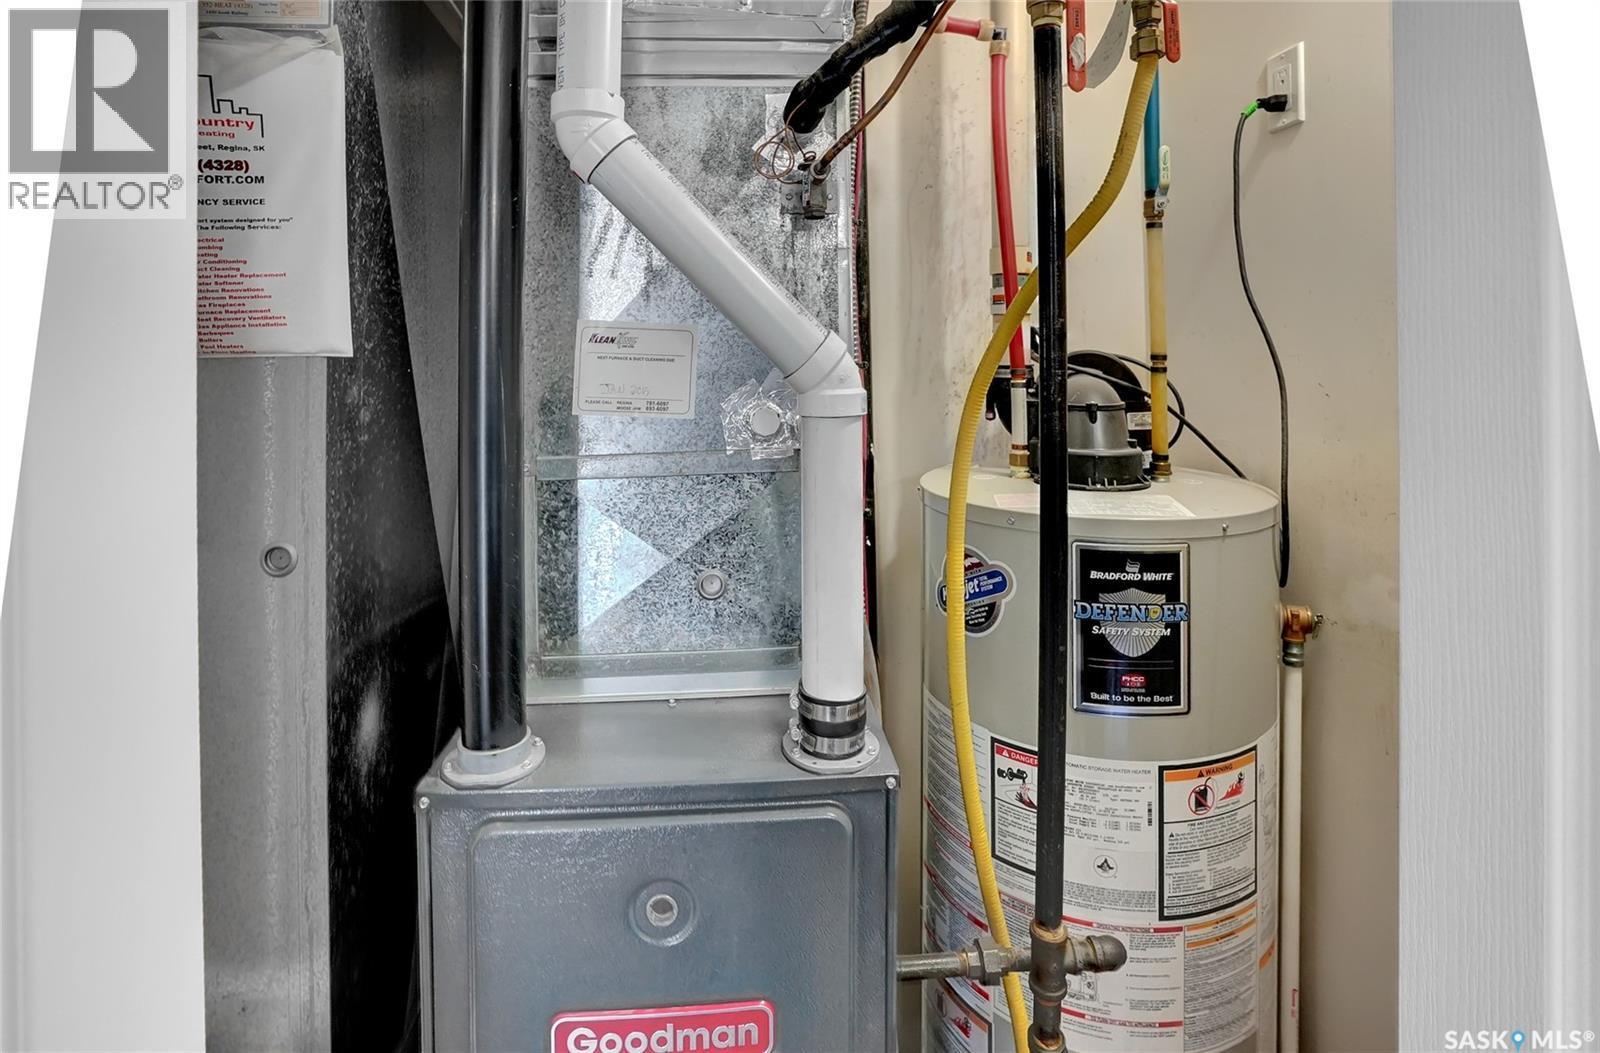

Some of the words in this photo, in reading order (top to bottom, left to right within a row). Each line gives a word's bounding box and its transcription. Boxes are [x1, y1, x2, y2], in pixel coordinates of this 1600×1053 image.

[218, 144, 250, 152] Regina,
[198, 159, 249, 173] (4328)
[198, 175, 264, 184] FORT.COM
[1090, 570, 1141, 581] BRADFORD
[1143, 572, 1173, 581] WHITE
[1074, 601, 1189, 623] DEFENDER
[1091, 625, 1130, 636] SAFETY
[1131, 627, 1171, 637] SYSTEM
[1090, 692, 1110, 701] Built
[1112, 694, 1121, 702] to
[1153, 695, 1173, 703] Best
[1205, 764, 1233, 775] WARNING
[567, 1022, 759, 1053] Goodman
